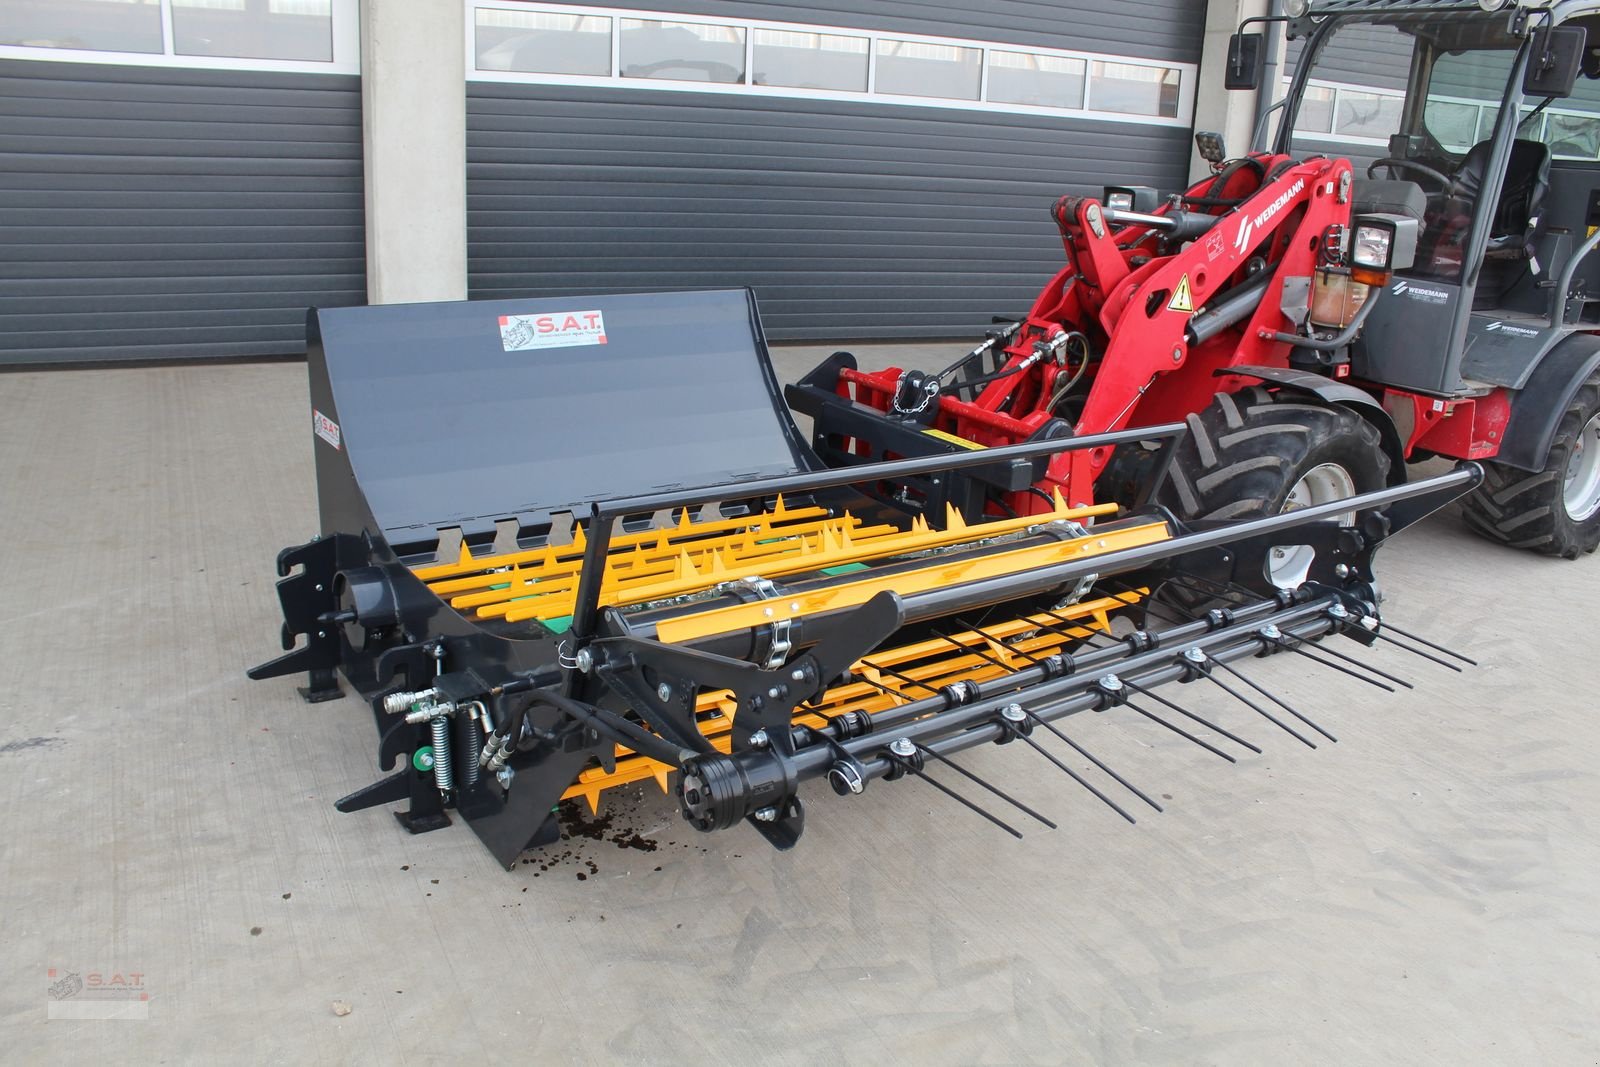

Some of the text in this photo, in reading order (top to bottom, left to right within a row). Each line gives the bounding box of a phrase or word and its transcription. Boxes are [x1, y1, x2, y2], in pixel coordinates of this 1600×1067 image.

[1254, 177, 1305, 228] WEIDEMANN
[1408, 286, 1449, 299] WEIDEMANN
[536, 314, 601, 333] S.A.T.
[1501, 325, 1539, 336] WEIDEMANN
